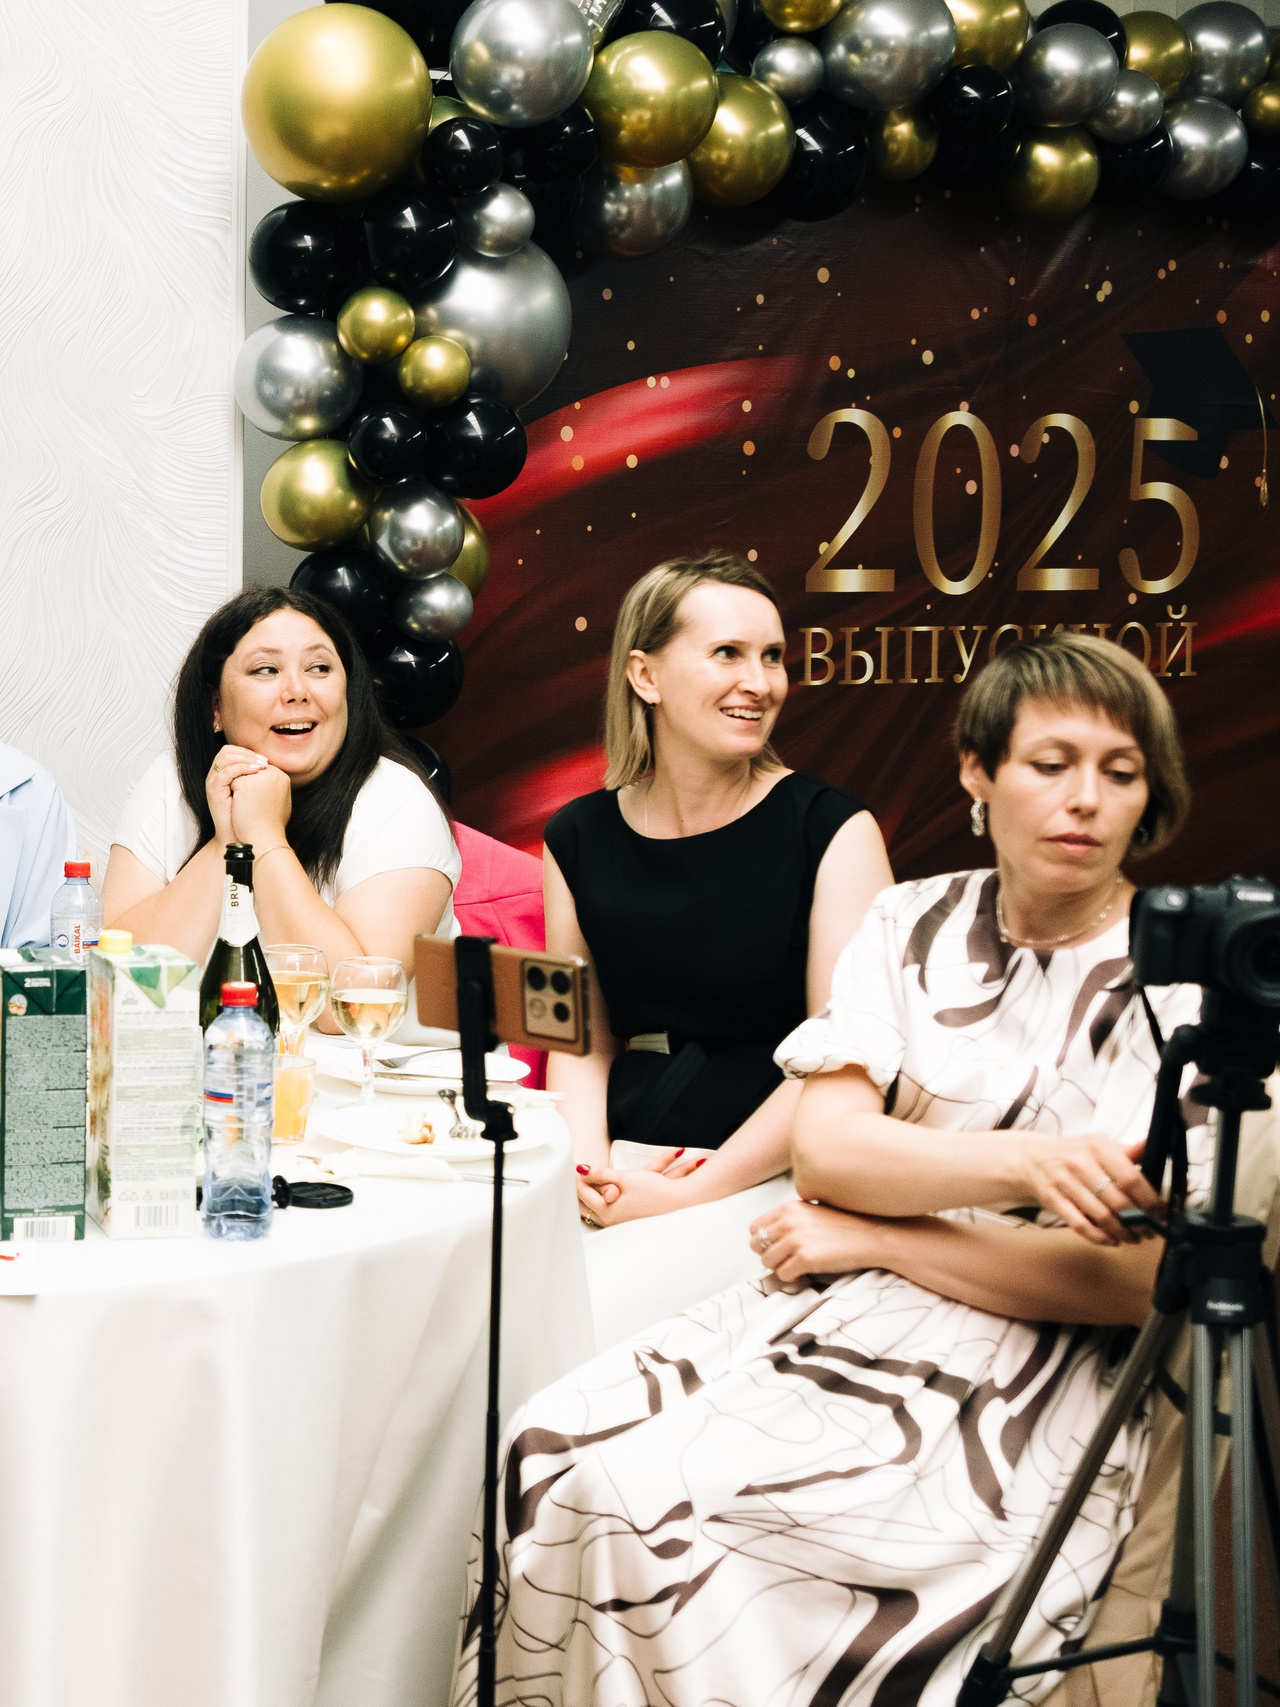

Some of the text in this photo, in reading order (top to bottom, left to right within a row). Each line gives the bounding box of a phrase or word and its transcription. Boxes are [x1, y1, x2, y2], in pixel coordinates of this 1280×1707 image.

[805, 408, 1200, 595] 2025
[798, 604, 1199, 686] ВЫПУСОЙ
[230, 884, 239, 907] BRU
[73, 925, 81, 954] BAIKAL
